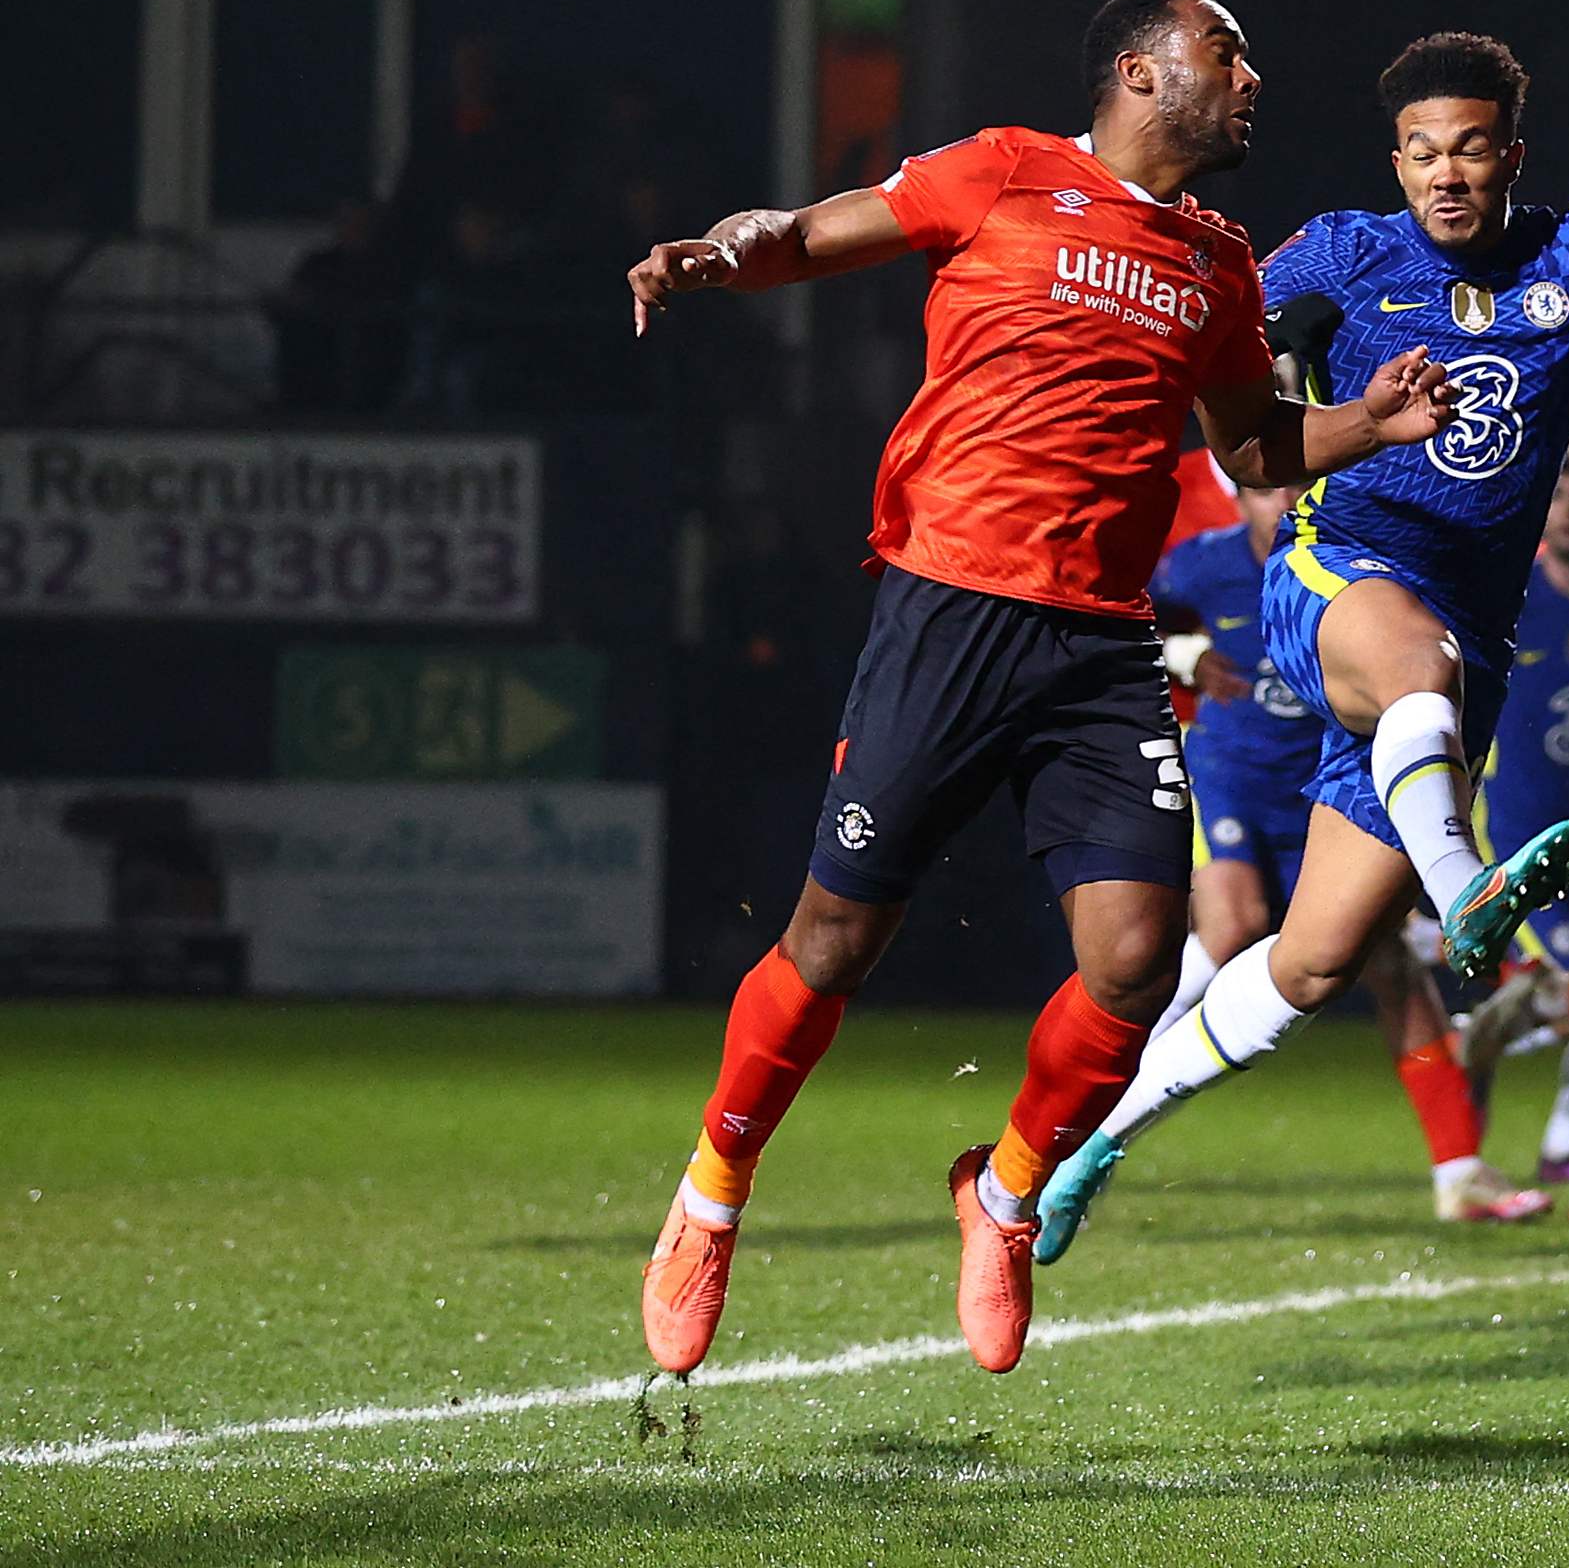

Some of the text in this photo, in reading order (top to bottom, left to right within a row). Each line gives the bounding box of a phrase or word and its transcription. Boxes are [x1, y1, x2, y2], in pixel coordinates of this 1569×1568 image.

[1050, 282, 1172, 338] life with power
[1056, 245, 1177, 317] utilita
[29, 443, 522, 518] Recruitment
[131, 520, 520, 606] 383033
